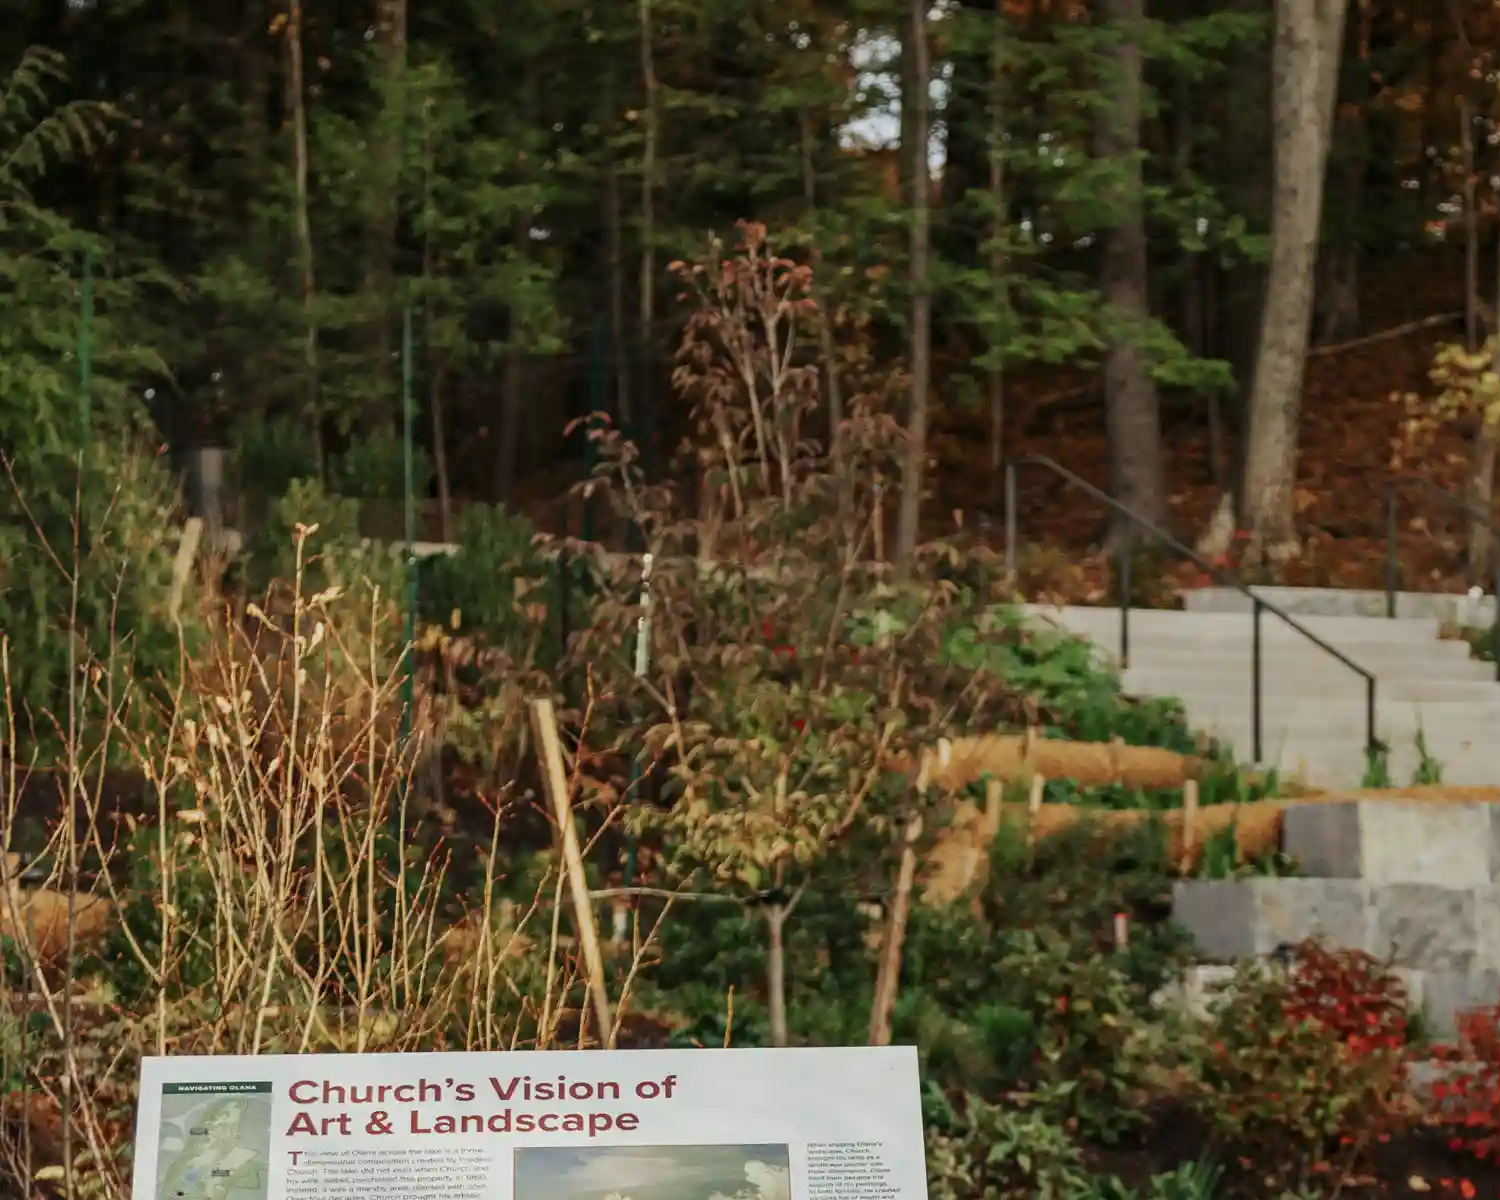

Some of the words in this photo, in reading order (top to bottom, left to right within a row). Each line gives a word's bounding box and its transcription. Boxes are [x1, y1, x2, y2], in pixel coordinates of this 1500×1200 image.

[288, 1078, 476, 1104] Church’s
[489, 1075, 620, 1101] Vision
[635, 1074, 677, 1099] of
[285, 1111, 352, 1136] Art
[364, 1111, 394, 1135] &
[409, 1108, 640, 1137] Landscape
